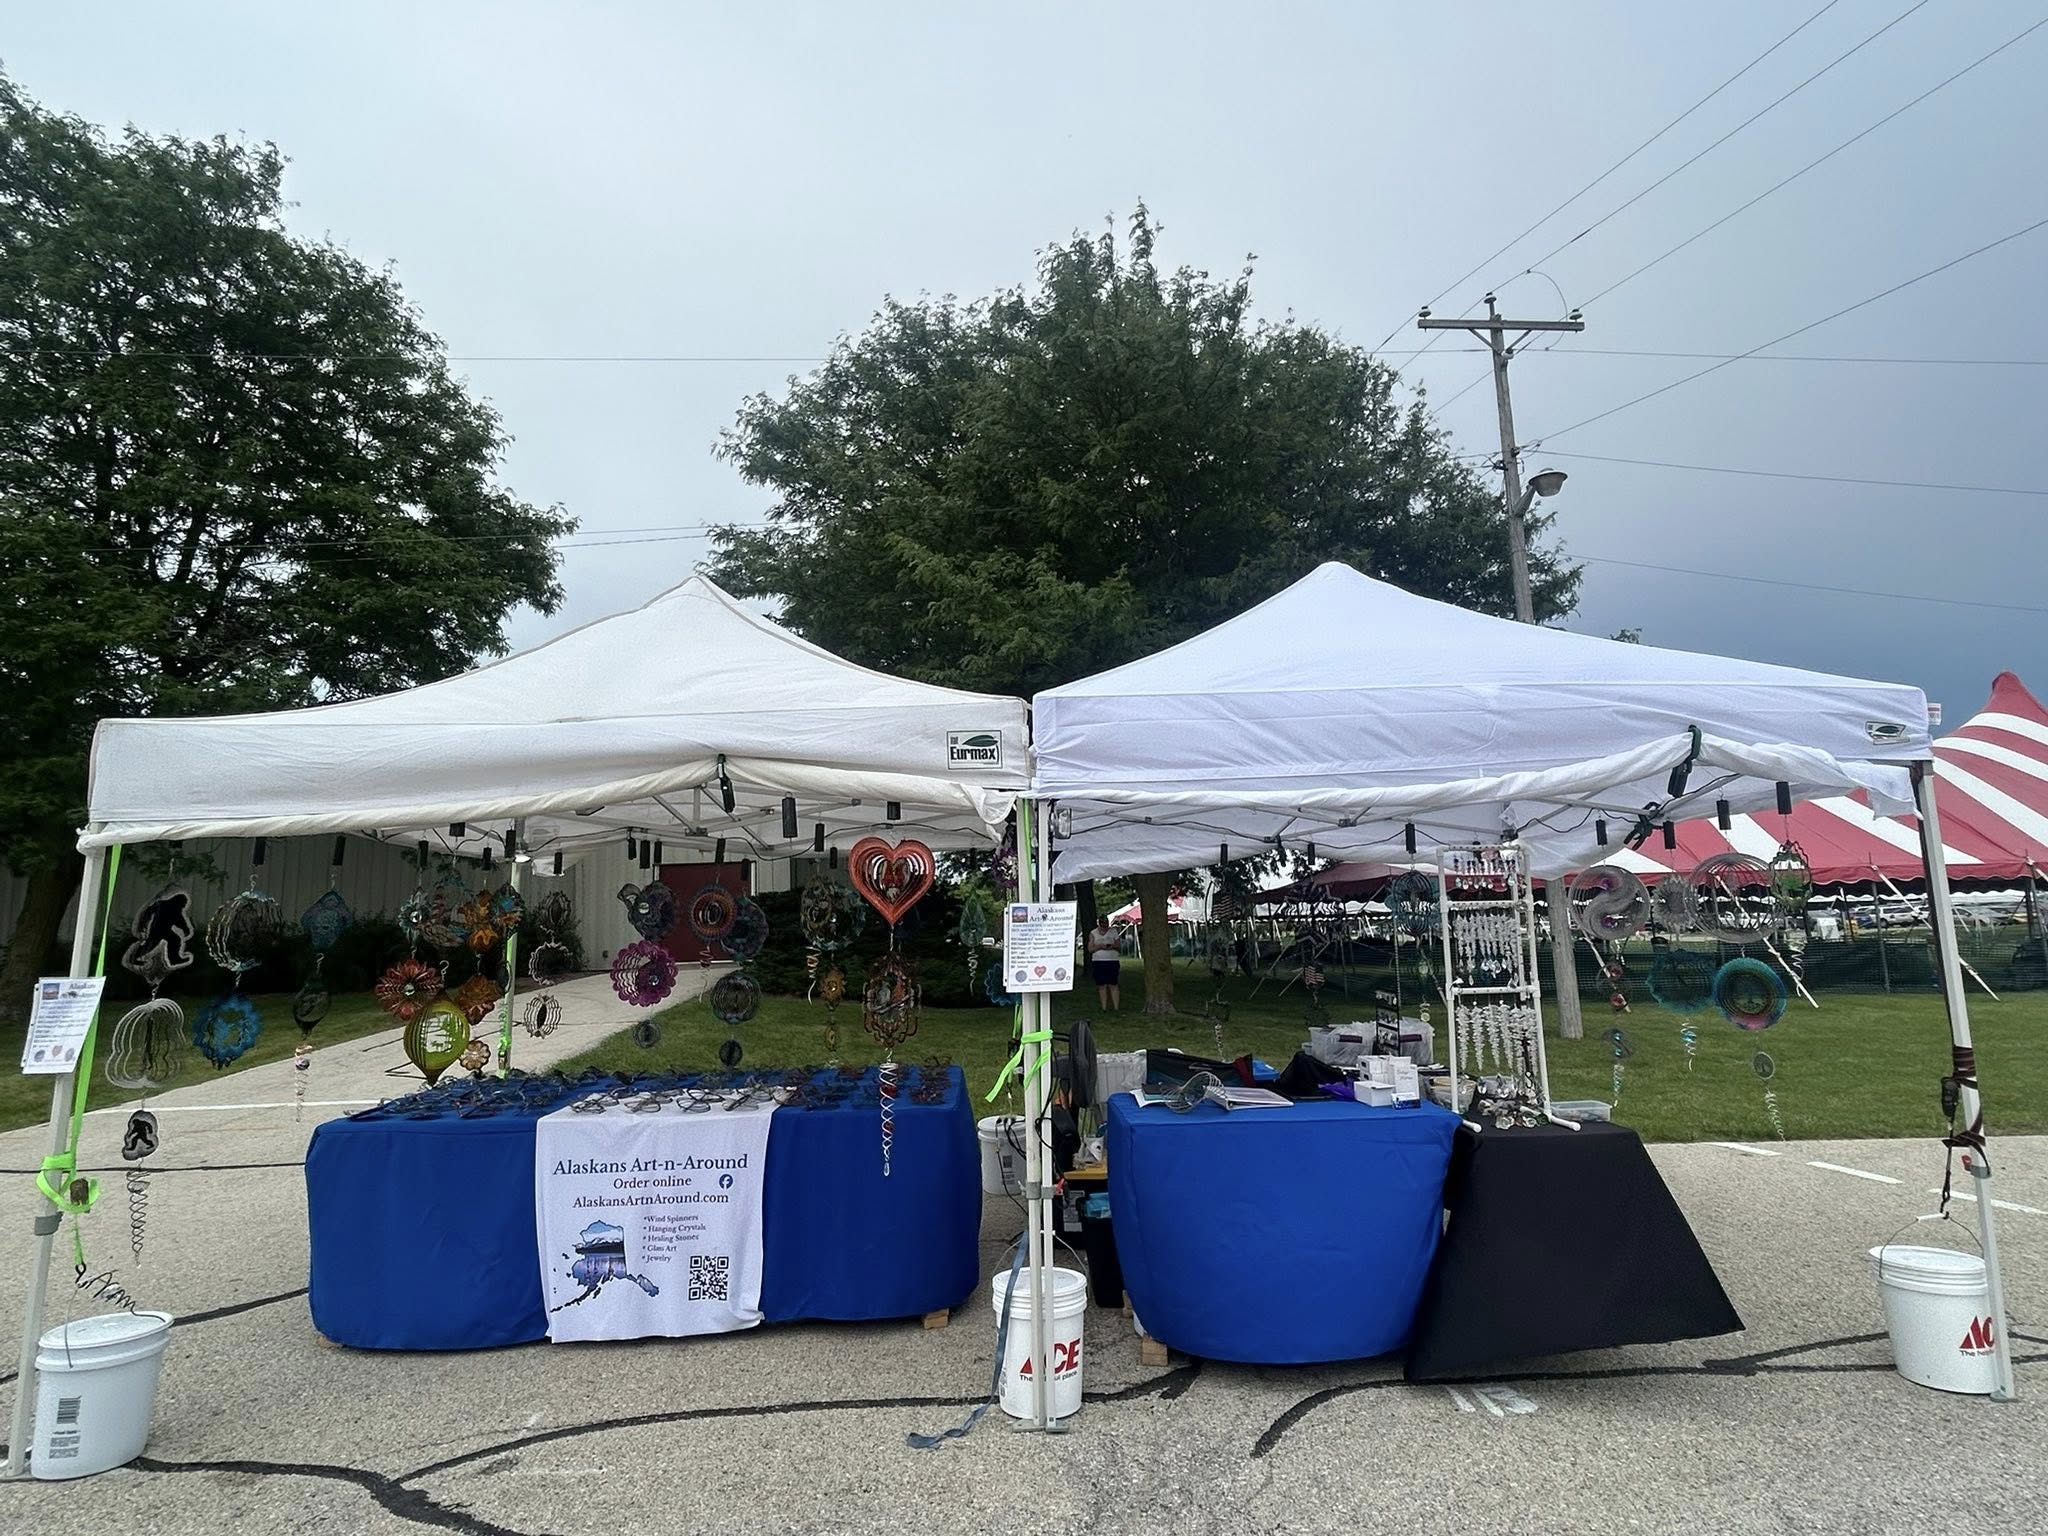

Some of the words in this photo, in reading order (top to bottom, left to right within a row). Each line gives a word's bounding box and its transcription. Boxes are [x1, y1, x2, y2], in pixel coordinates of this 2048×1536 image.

[950, 747, 996, 760] Eurmax
[552, 1159, 627, 1175] Alaskans
[629, 1154, 749, 1173] Art-n-Around
[613, 1177, 650, 1189] Order
[652, 1176, 692, 1188] online
[572, 1192, 729, 1208] AlaskansArtnAround.com
[667, 1214, 699, 1224] Spinners
[648, 1225, 677, 1234] Hanging
[678, 1223, 706, 1232] Crystals
[648, 1235, 674, 1243] Healing
[675, 1234, 699, 1242] Stones
[645, 1255, 672, 1263] Jewelry
[1959, 1315, 1995, 1349] AC
[1020, 1374, 1033, 1382] The
